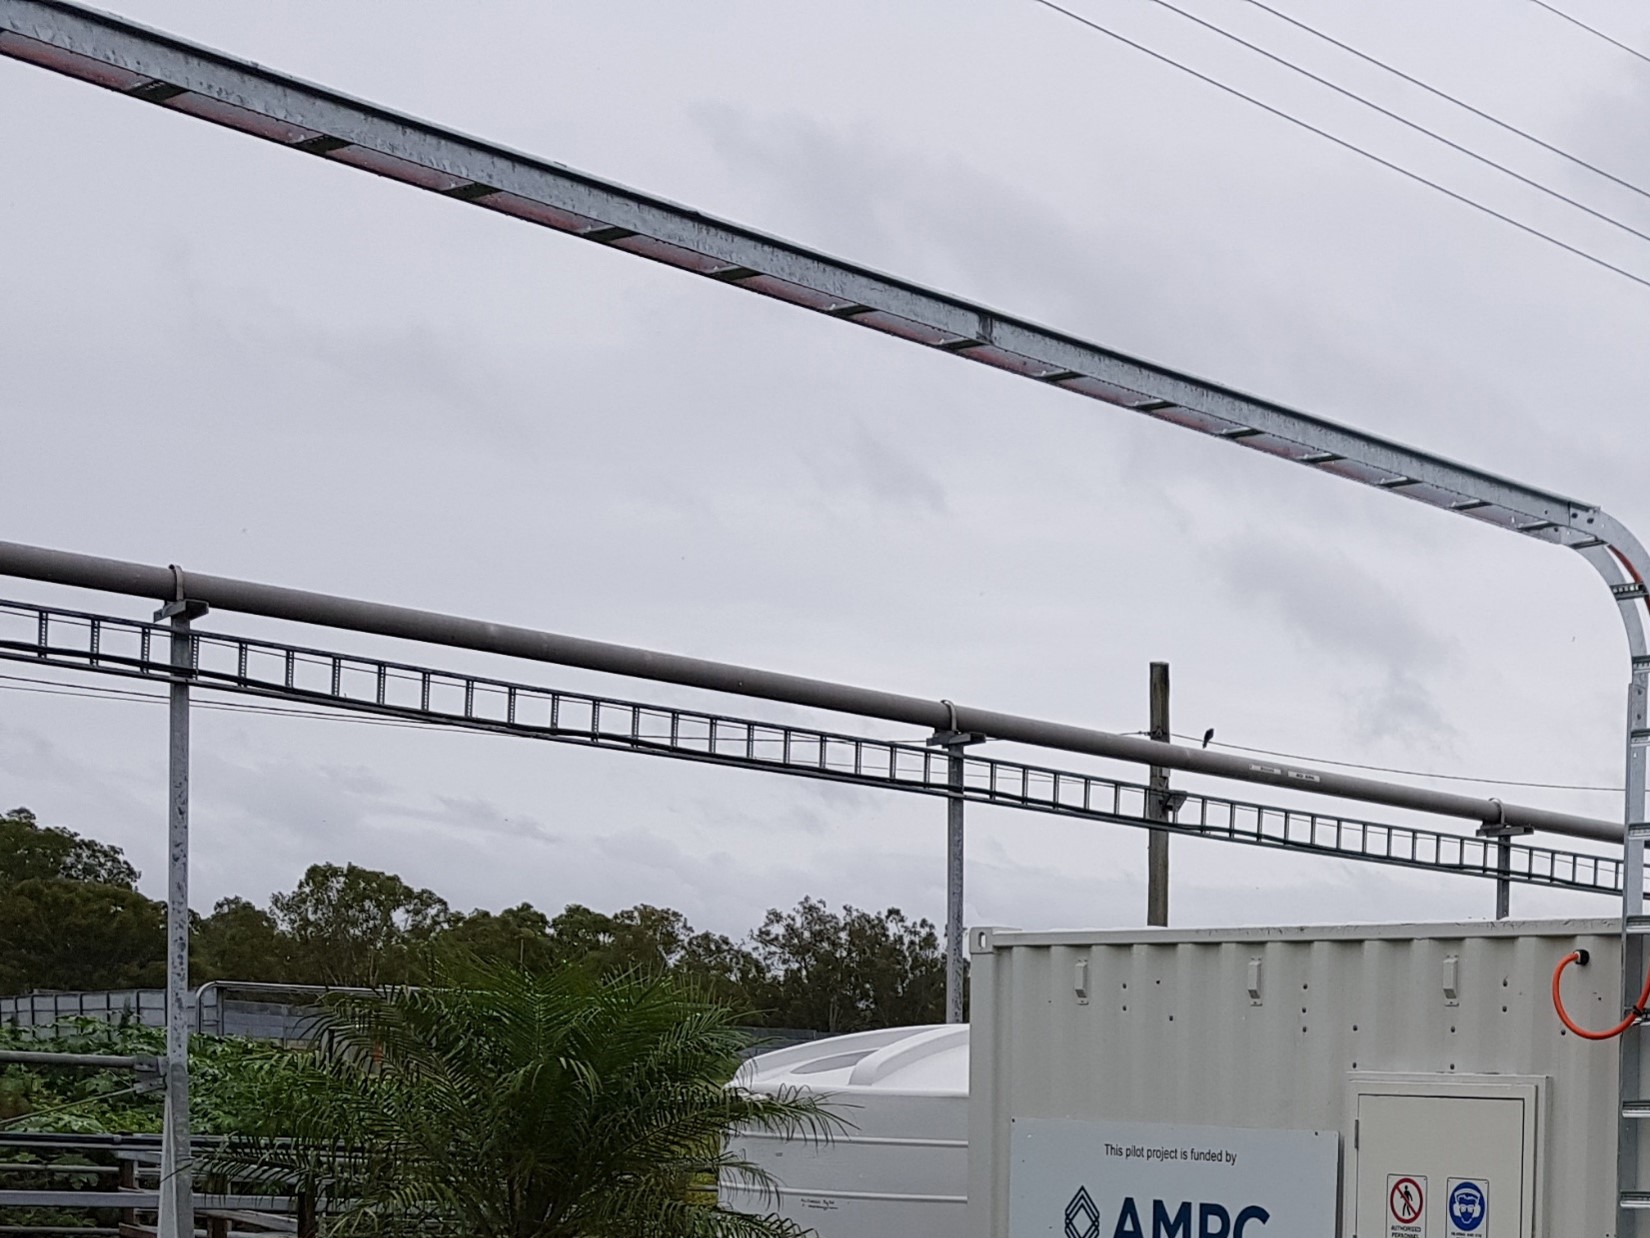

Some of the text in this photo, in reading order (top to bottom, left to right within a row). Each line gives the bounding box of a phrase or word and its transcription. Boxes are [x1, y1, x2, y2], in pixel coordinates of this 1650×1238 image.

[1104, 1143, 1237, 1166] This pilot project is funded by
